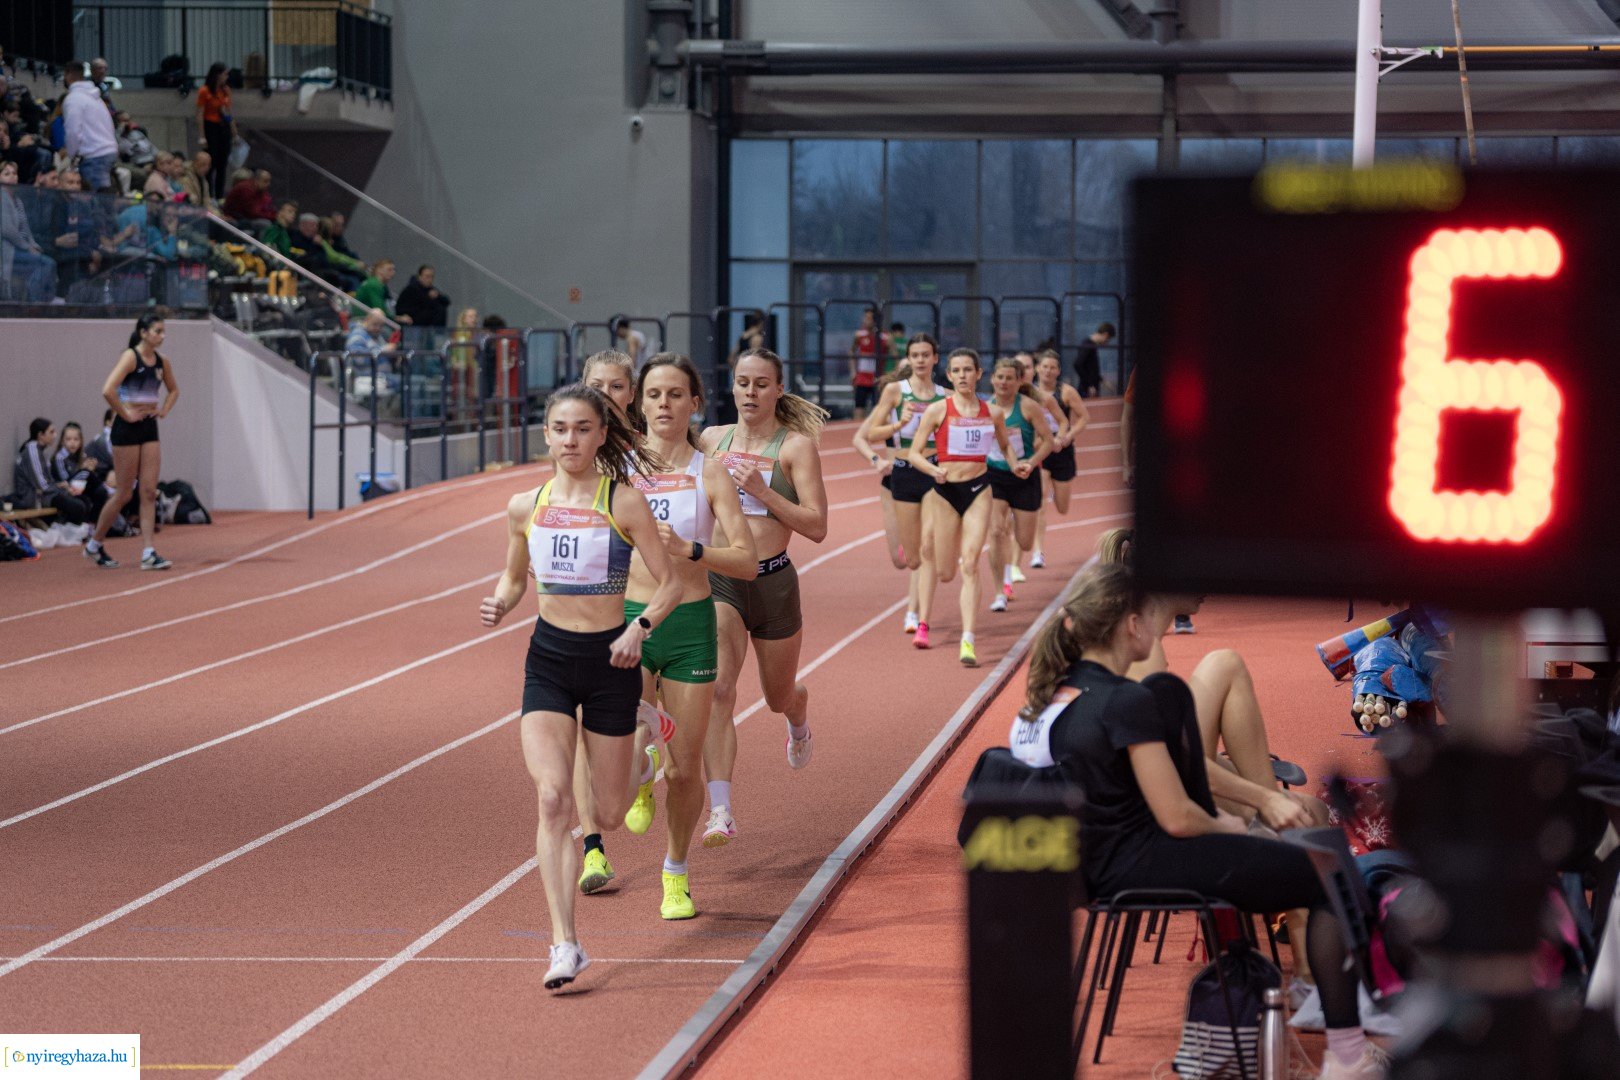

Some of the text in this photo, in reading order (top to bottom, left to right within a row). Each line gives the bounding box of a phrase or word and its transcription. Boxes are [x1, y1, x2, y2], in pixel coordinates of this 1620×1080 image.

[1389, 227, 1562, 544] 6
[965, 429, 981, 443] 119
[551, 534, 579, 559] 161
[551, 561, 575, 573] MUSZIL
[769, 553, 789, 571] PR
